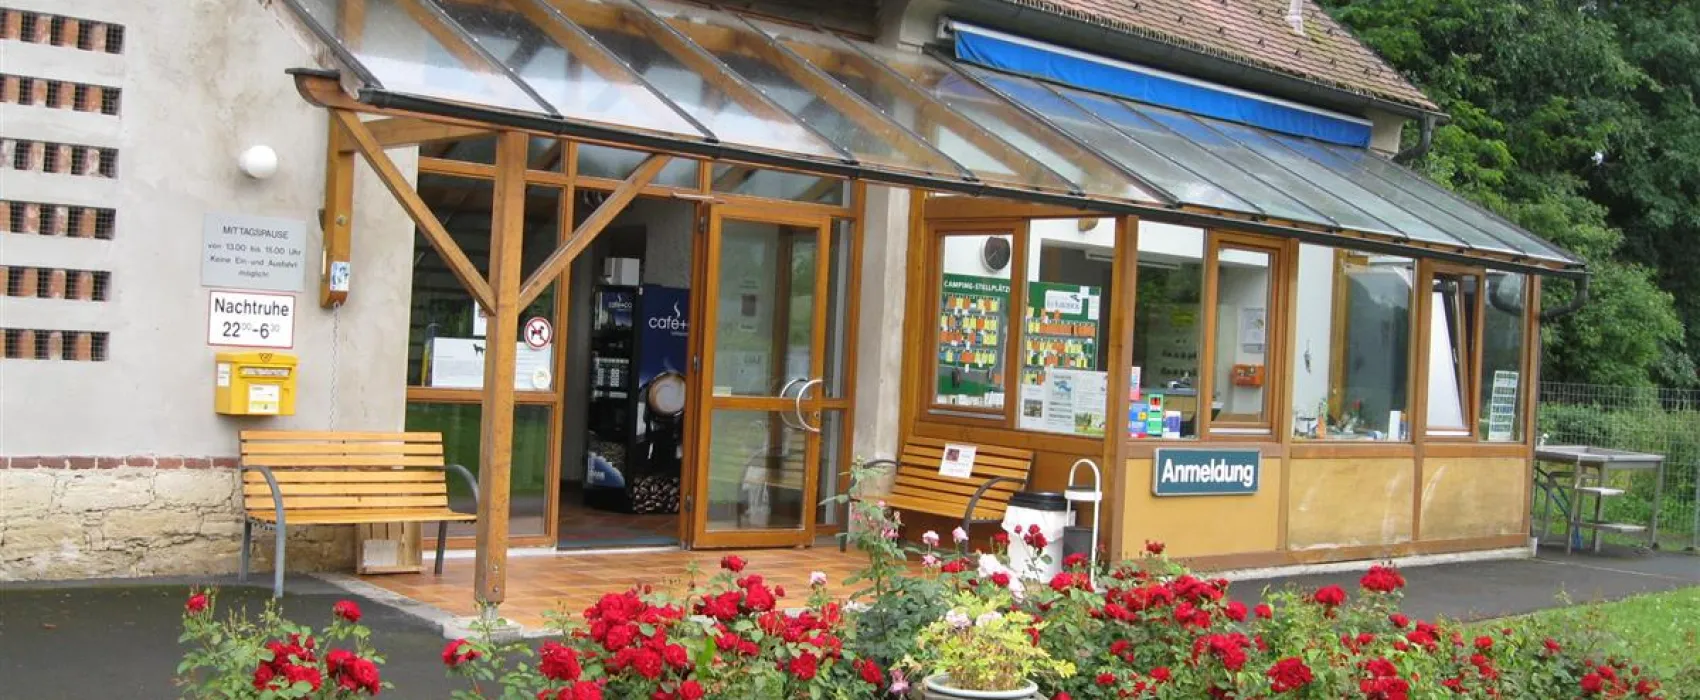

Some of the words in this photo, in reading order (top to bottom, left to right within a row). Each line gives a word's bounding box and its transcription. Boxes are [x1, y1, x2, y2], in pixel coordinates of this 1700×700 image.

[223, 225, 289, 239] MITTAGSPAUSE
[210, 255, 231, 263] Keine
[268, 260, 298, 268] Ausfahrt
[214, 297, 289, 316] Nachtruhe
[1161, 458, 1255, 488] Anmeldung
